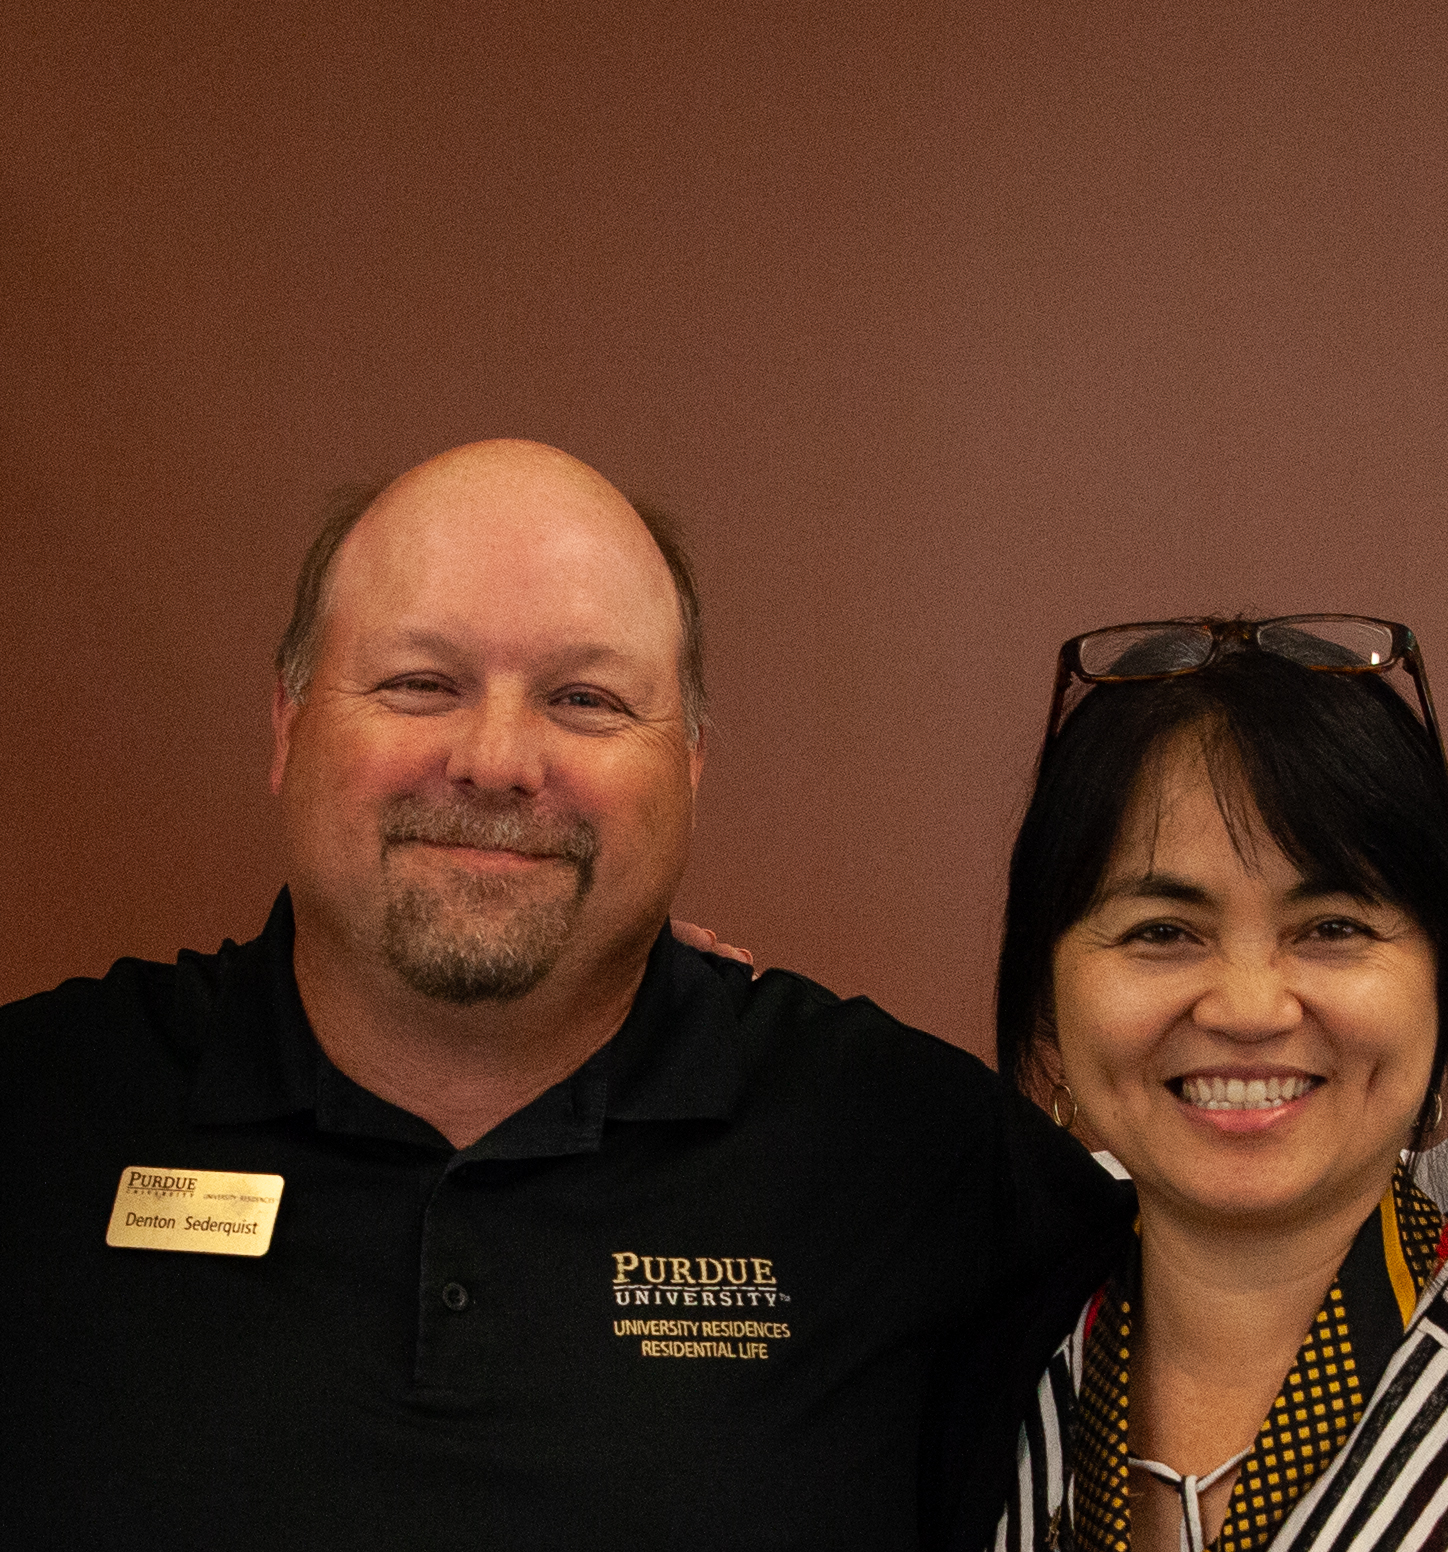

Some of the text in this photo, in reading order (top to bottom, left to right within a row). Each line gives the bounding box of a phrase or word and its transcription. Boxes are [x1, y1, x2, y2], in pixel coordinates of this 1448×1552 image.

[128, 1171, 198, 1190] PURDUE
[125, 1212, 259, 1237] Denton Sederquist
[612, 1252, 777, 1284] PURDUE
[615, 1290, 777, 1307] UNIVERSITY
[613, 1319, 791, 1339] UNIVERSITY RESIDENCES
[641, 1339, 769, 1360] RESIDENTIAL LIFE
